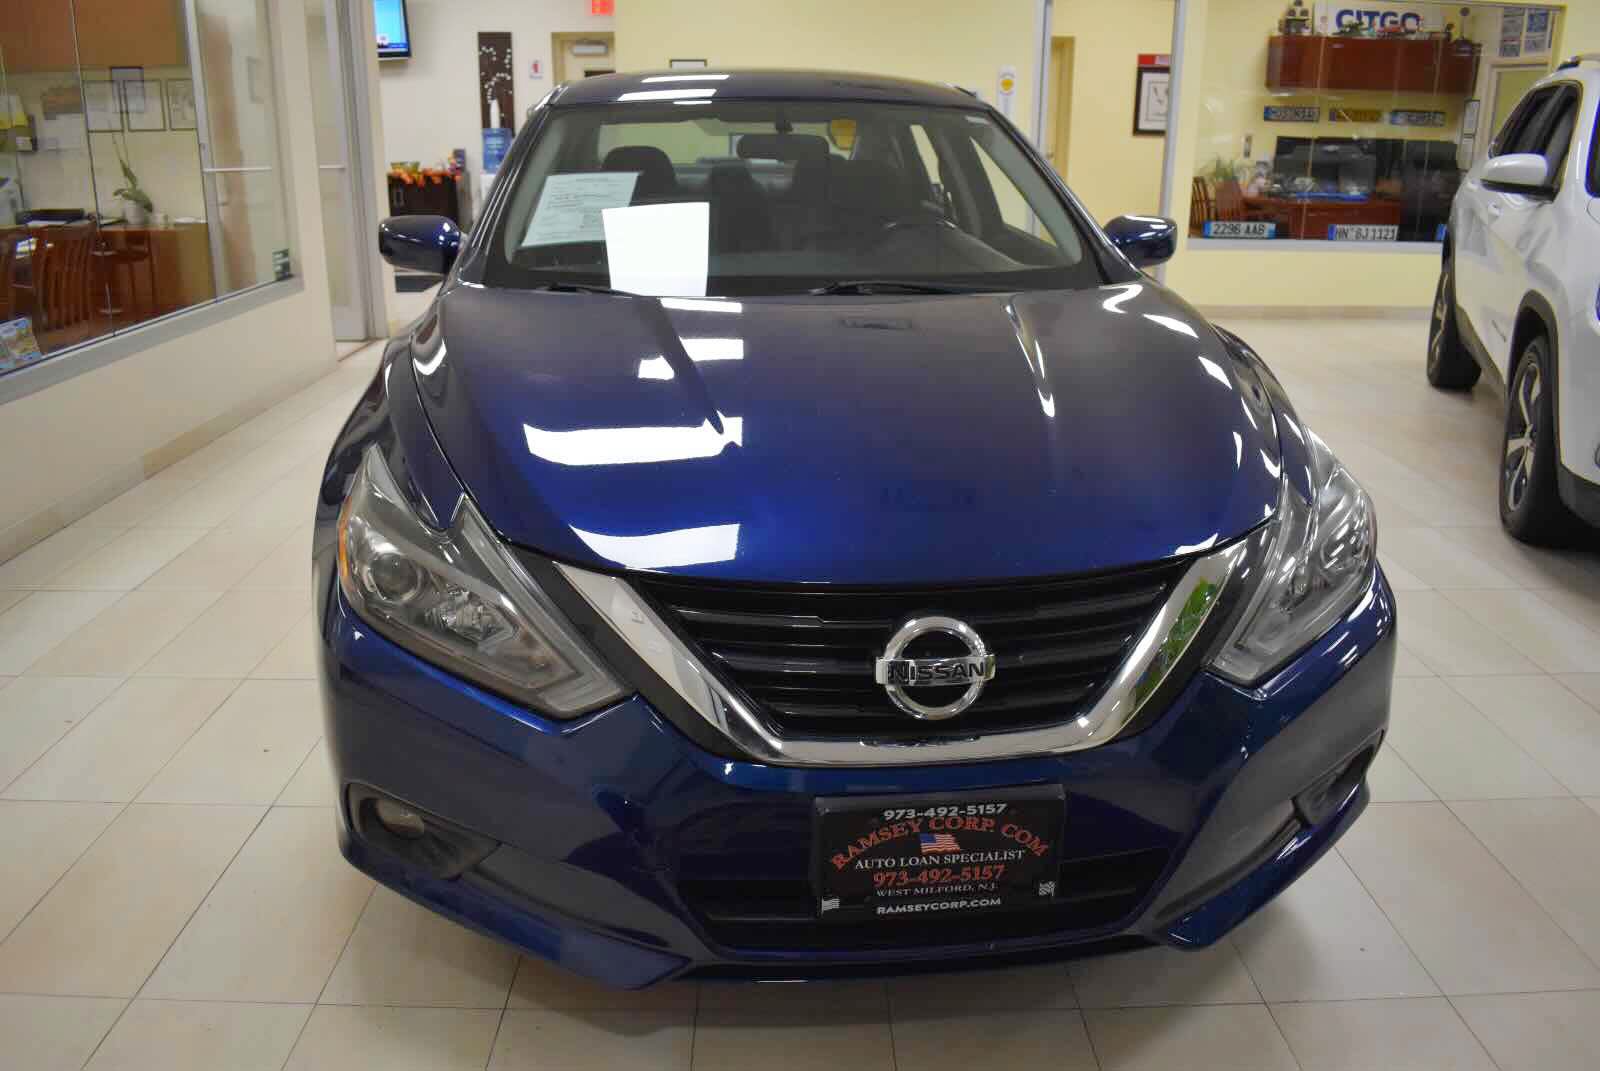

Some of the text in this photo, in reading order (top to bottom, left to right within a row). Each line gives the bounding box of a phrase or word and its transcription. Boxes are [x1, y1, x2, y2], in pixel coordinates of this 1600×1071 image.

[1335, 9, 1421, 34] CITGO
[887, 660, 986, 683] NISSAN
[883, 803, 1008, 821] 973-492-5157
[831, 818, 922, 871] RAMSEY
[1000, 822, 1050, 857] COM
[855, 849, 1026, 870] AUTO LOAN SPECIALIST
[873, 864, 1006, 888] 973-492-5157
[876, 887, 911, 898] WEST
[876, 898, 1002, 915] RAMSEYCORP.COM
